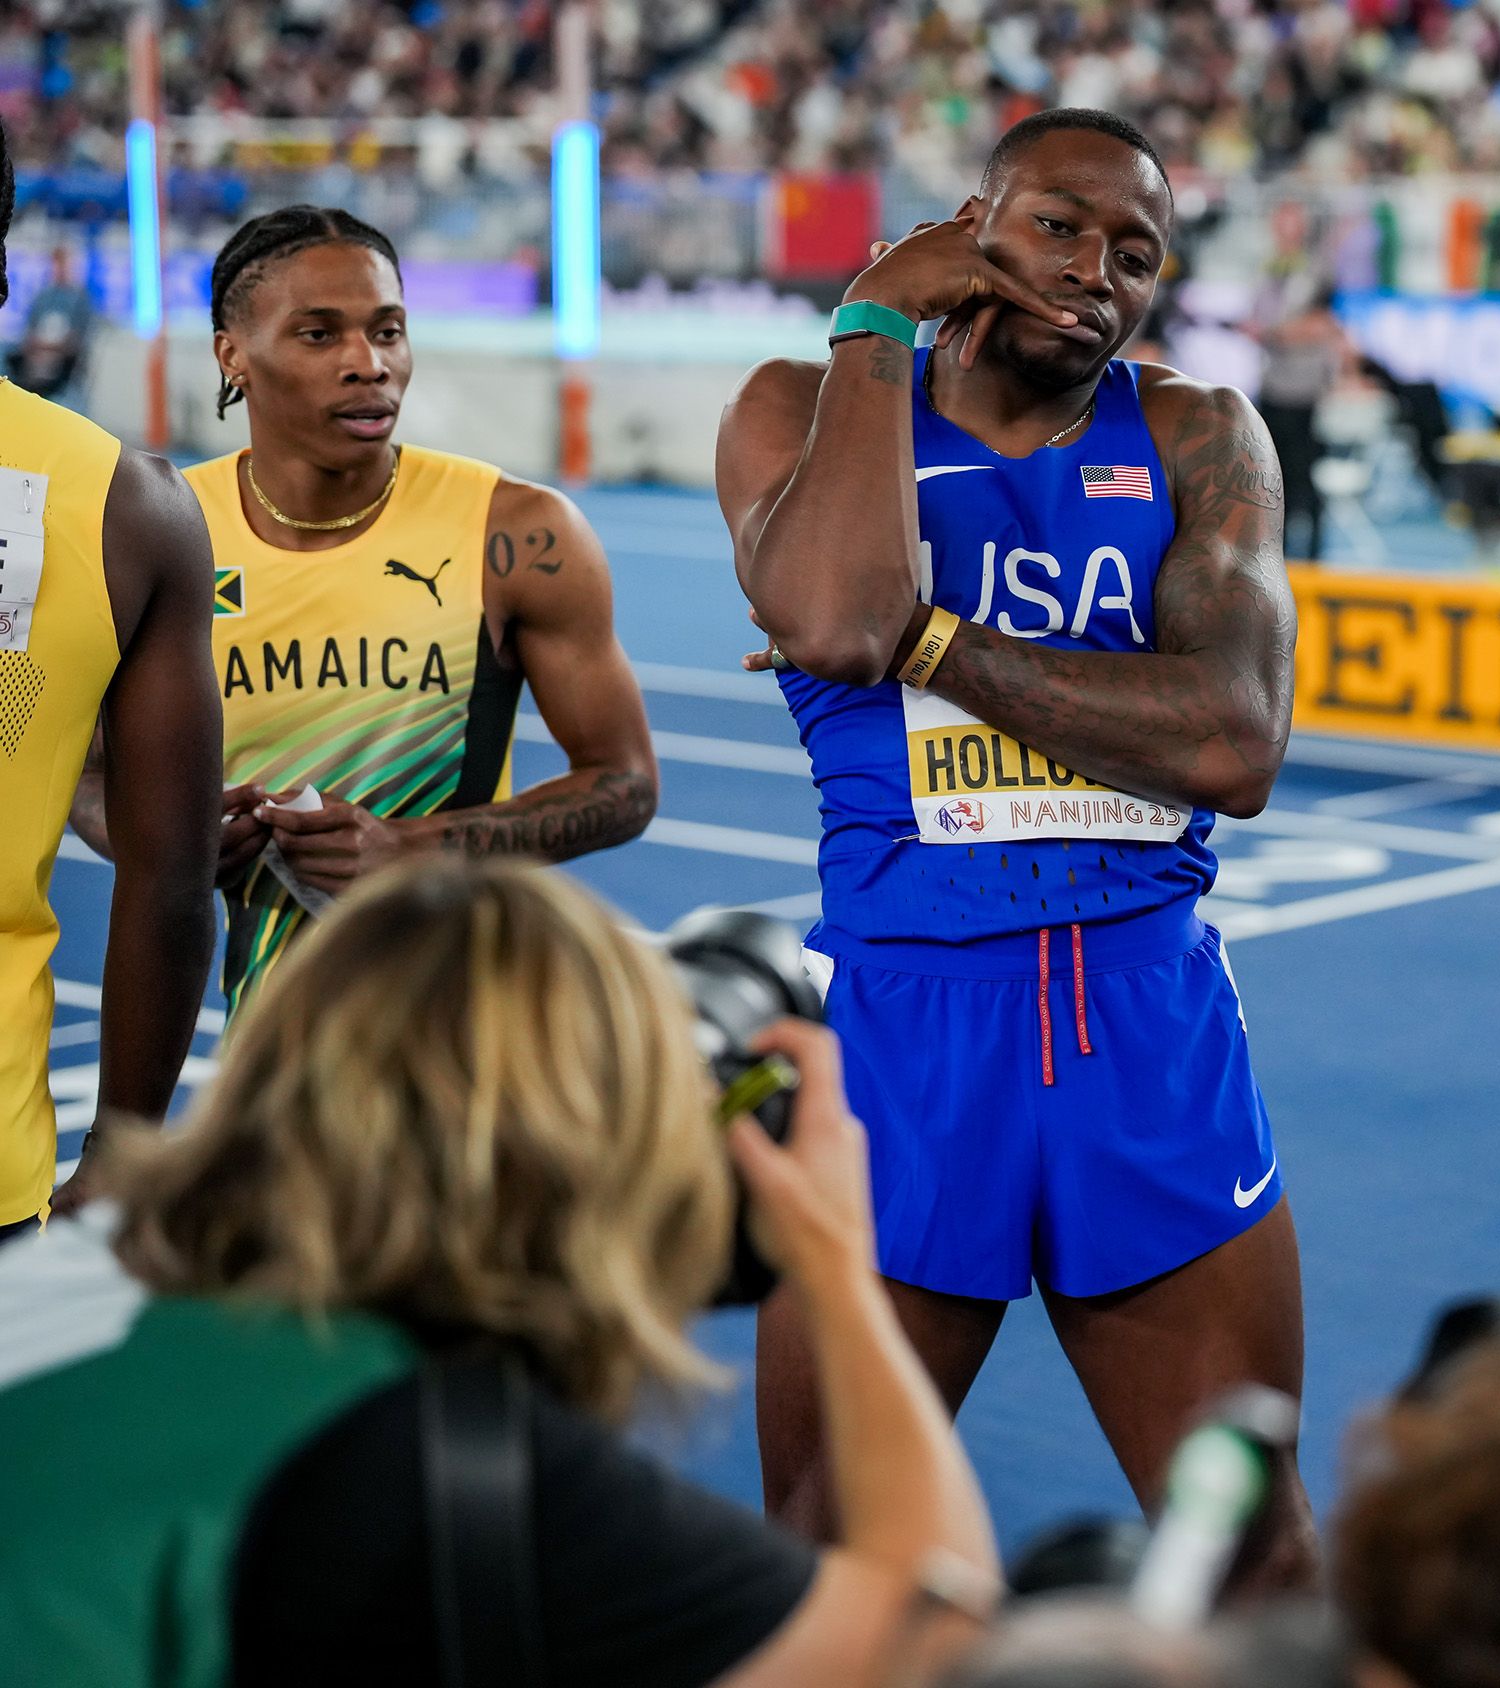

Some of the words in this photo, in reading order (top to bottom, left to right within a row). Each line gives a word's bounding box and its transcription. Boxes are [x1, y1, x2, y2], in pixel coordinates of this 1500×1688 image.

[920, 541, 1145, 644] USA
[225, 636, 450, 698] AMAICA
[922, 640, 940, 660] Got
[925, 734, 1098, 792] HOLL
[1010, 797, 1144, 829] NANJING
[1149, 805, 1181, 826] 25
